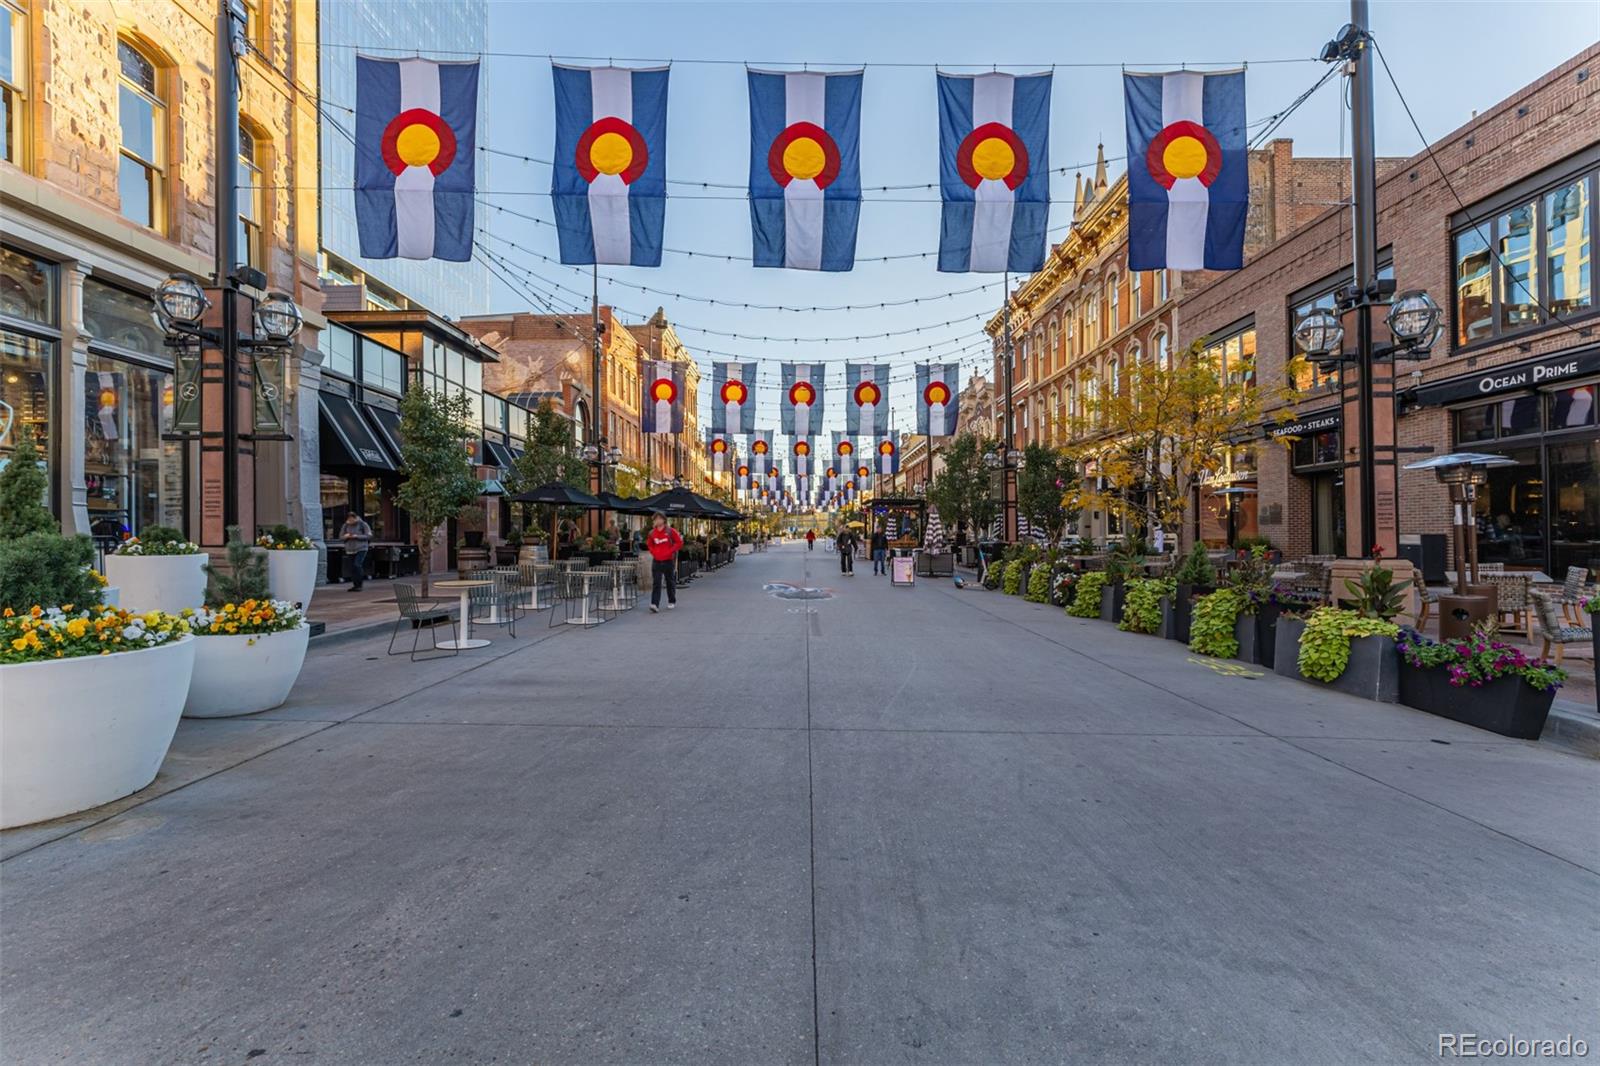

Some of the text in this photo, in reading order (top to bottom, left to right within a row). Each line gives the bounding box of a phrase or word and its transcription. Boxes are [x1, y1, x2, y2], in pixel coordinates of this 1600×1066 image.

[1479, 362, 1578, 392] OCEAN PRIME
[1308, 417, 1335, 430] STEAKS
